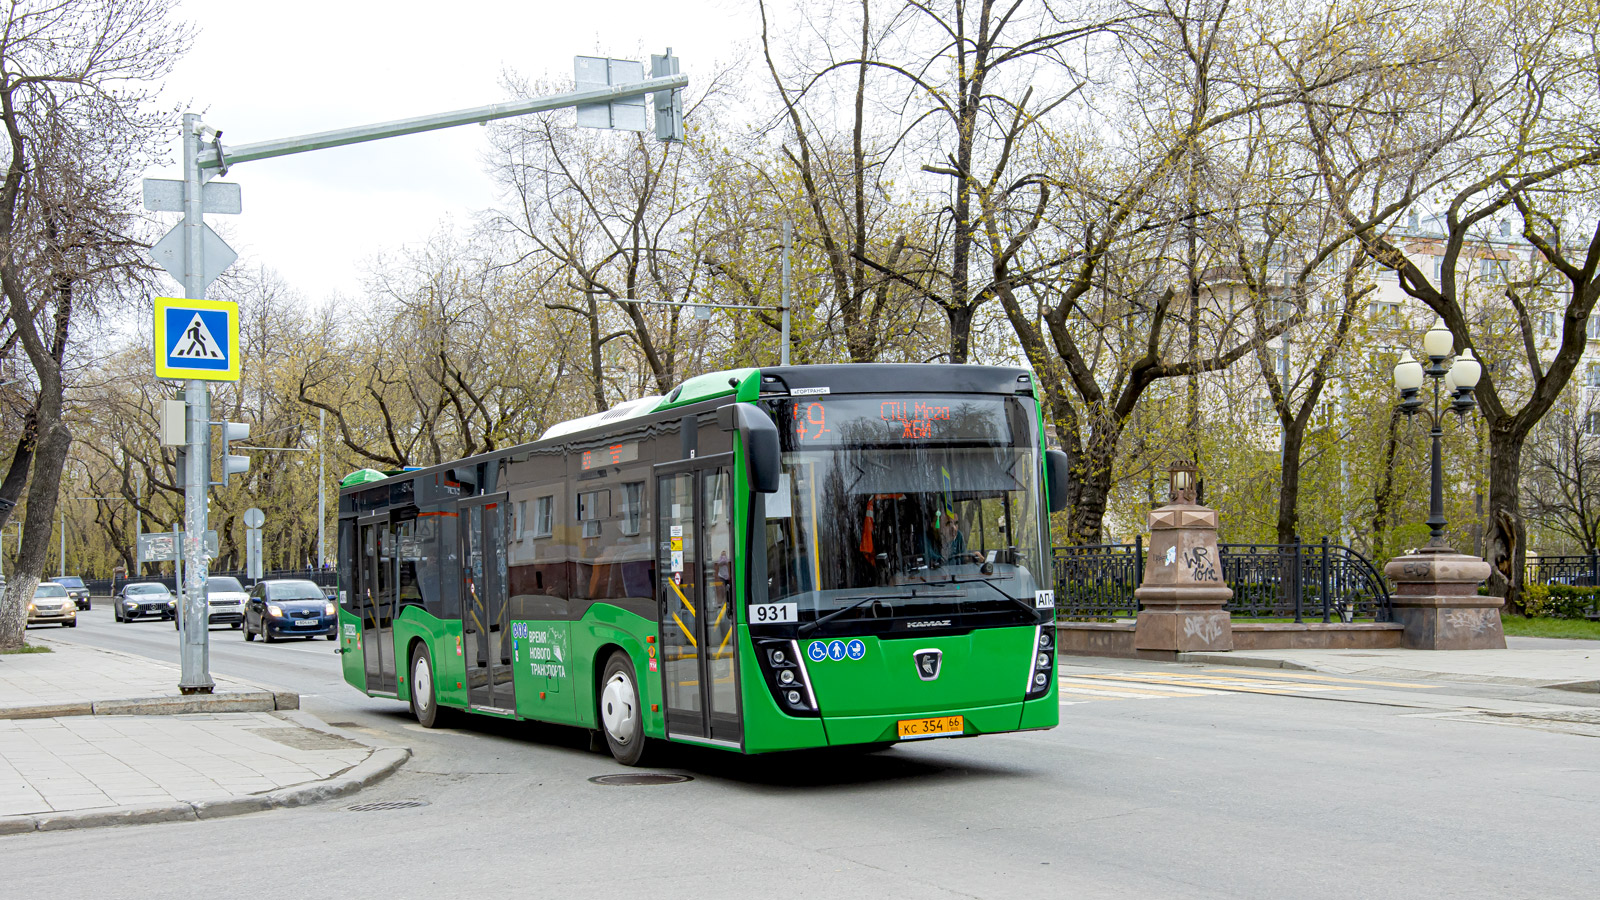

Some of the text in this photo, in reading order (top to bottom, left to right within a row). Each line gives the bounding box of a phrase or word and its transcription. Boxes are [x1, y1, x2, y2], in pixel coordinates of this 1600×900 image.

[757, 605, 788, 622] 931
[907, 620, 952, 628] KAMAZ
[529, 631, 547, 644] ВРЕМЯ
[529, 647, 551, 660] НОВОГО
[531, 663, 566, 678] ТРАНСПОРТА
[922, 719, 943, 733] 354
[949, 717, 960, 727] 66
